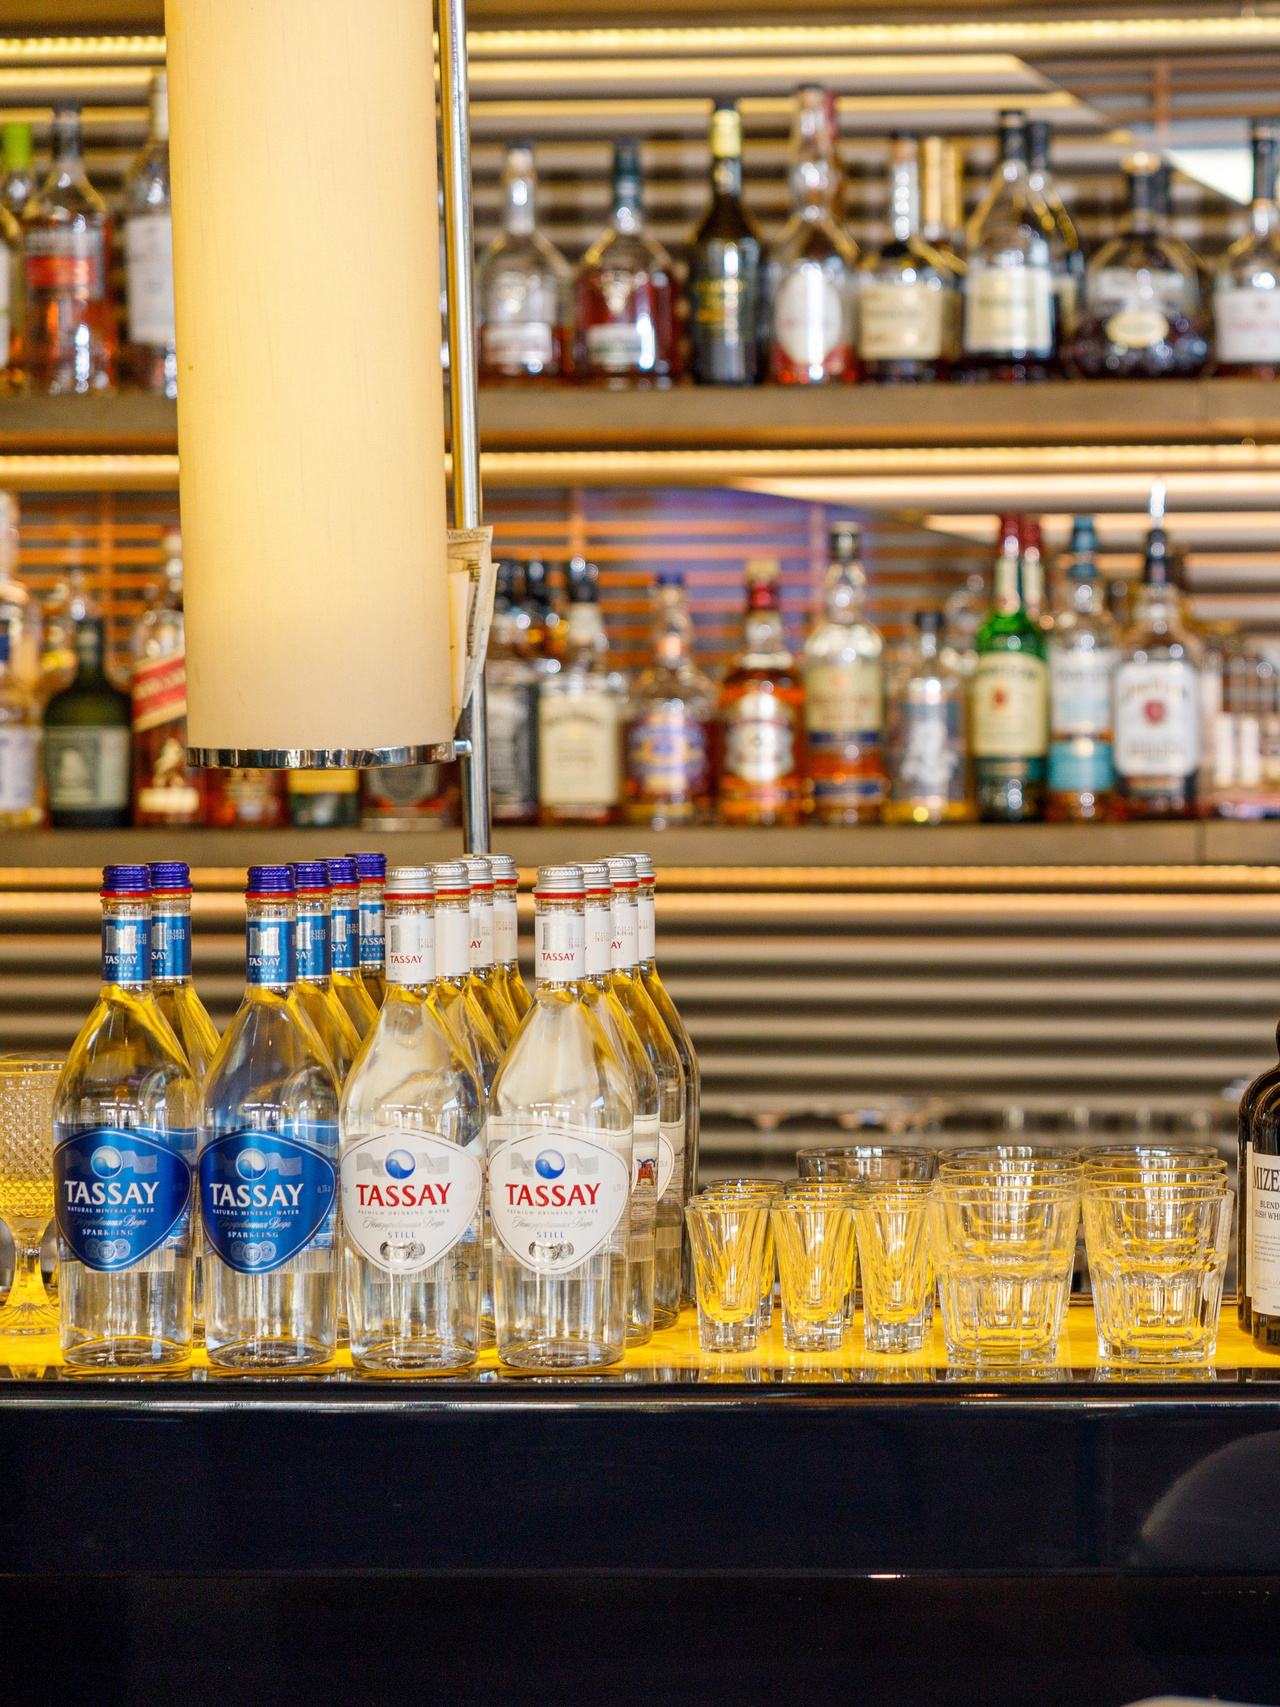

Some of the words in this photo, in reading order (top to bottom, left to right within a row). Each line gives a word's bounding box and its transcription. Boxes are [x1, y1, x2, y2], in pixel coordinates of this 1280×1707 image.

[331, 944, 347, 952] SAY
[105, 955, 138, 964] TASSAY
[151, 951, 168, 960] SAY
[296, 951, 311, 960] SAY
[390, 955, 423, 964] TASSAY
[542, 952, 575, 961] TASSAY
[248, 957, 280, 966] TASSAY
[64, 1180, 159, 1205] TASSAY
[209, 1183, 304, 1208] TASSAY
[355, 1182, 452, 1207] TASSAY
[505, 1182, 601, 1207] TASSAY
[213, 1208, 238, 1216] NATURAL
[82, 1228, 133, 1236] SPARKLING
[388, 1231, 416, 1239] STILL
[536, 1231, 565, 1239] STILL
